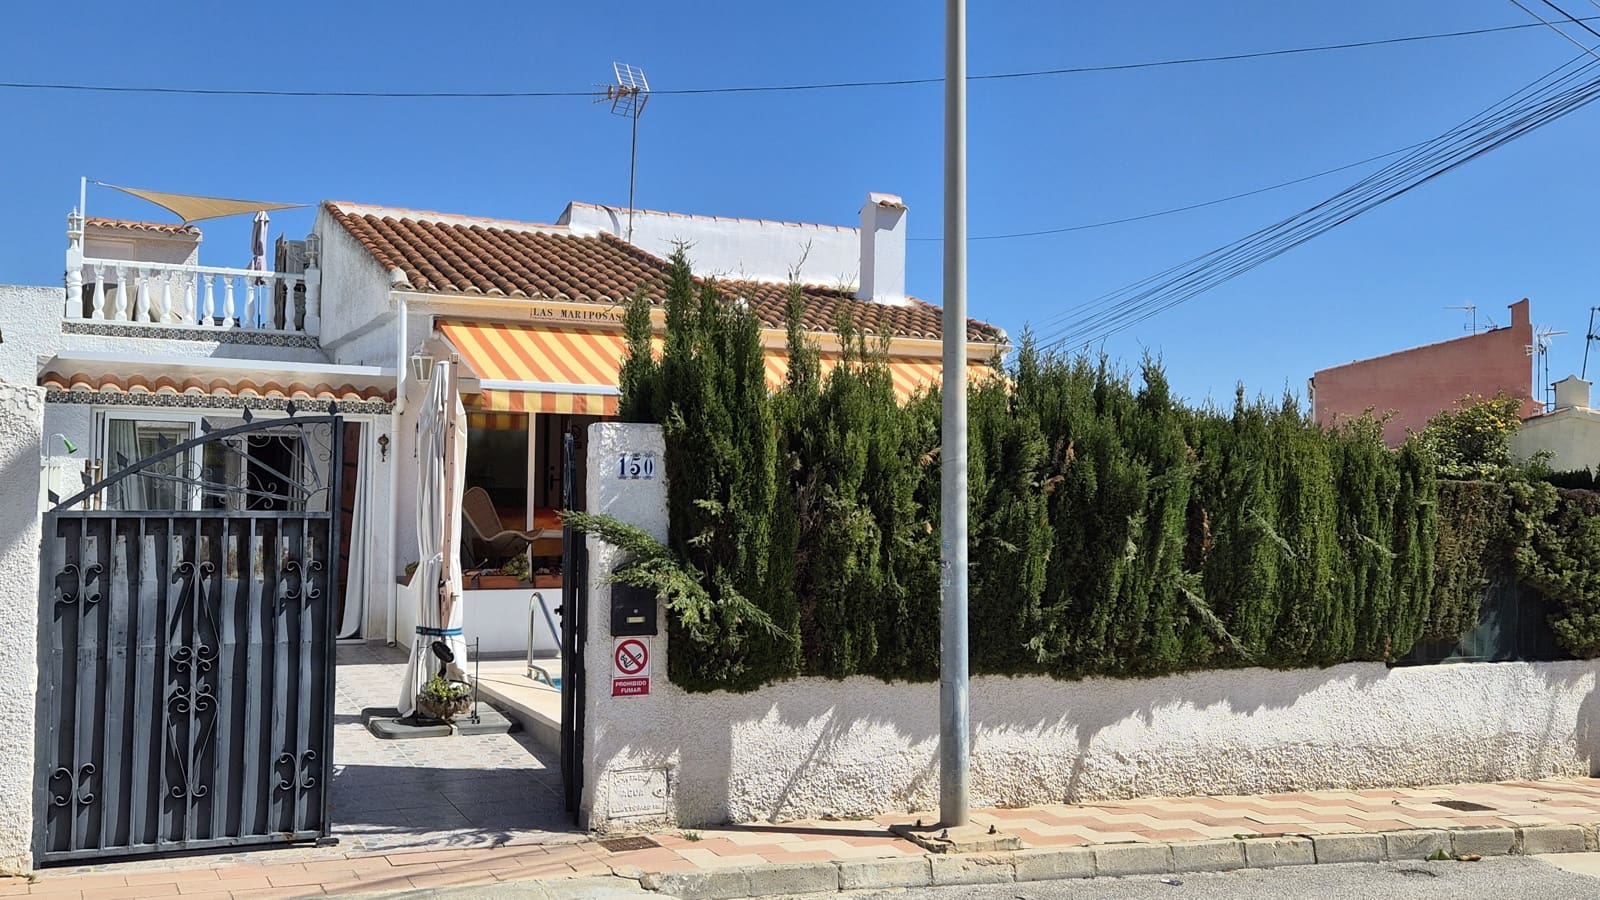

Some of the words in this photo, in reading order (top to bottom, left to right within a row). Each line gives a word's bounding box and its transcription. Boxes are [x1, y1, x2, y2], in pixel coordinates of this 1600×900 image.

[533, 308, 553, 317] LAS
[561, 309, 622, 321] MARIPOSAS
[619, 456, 653, 476] 150
